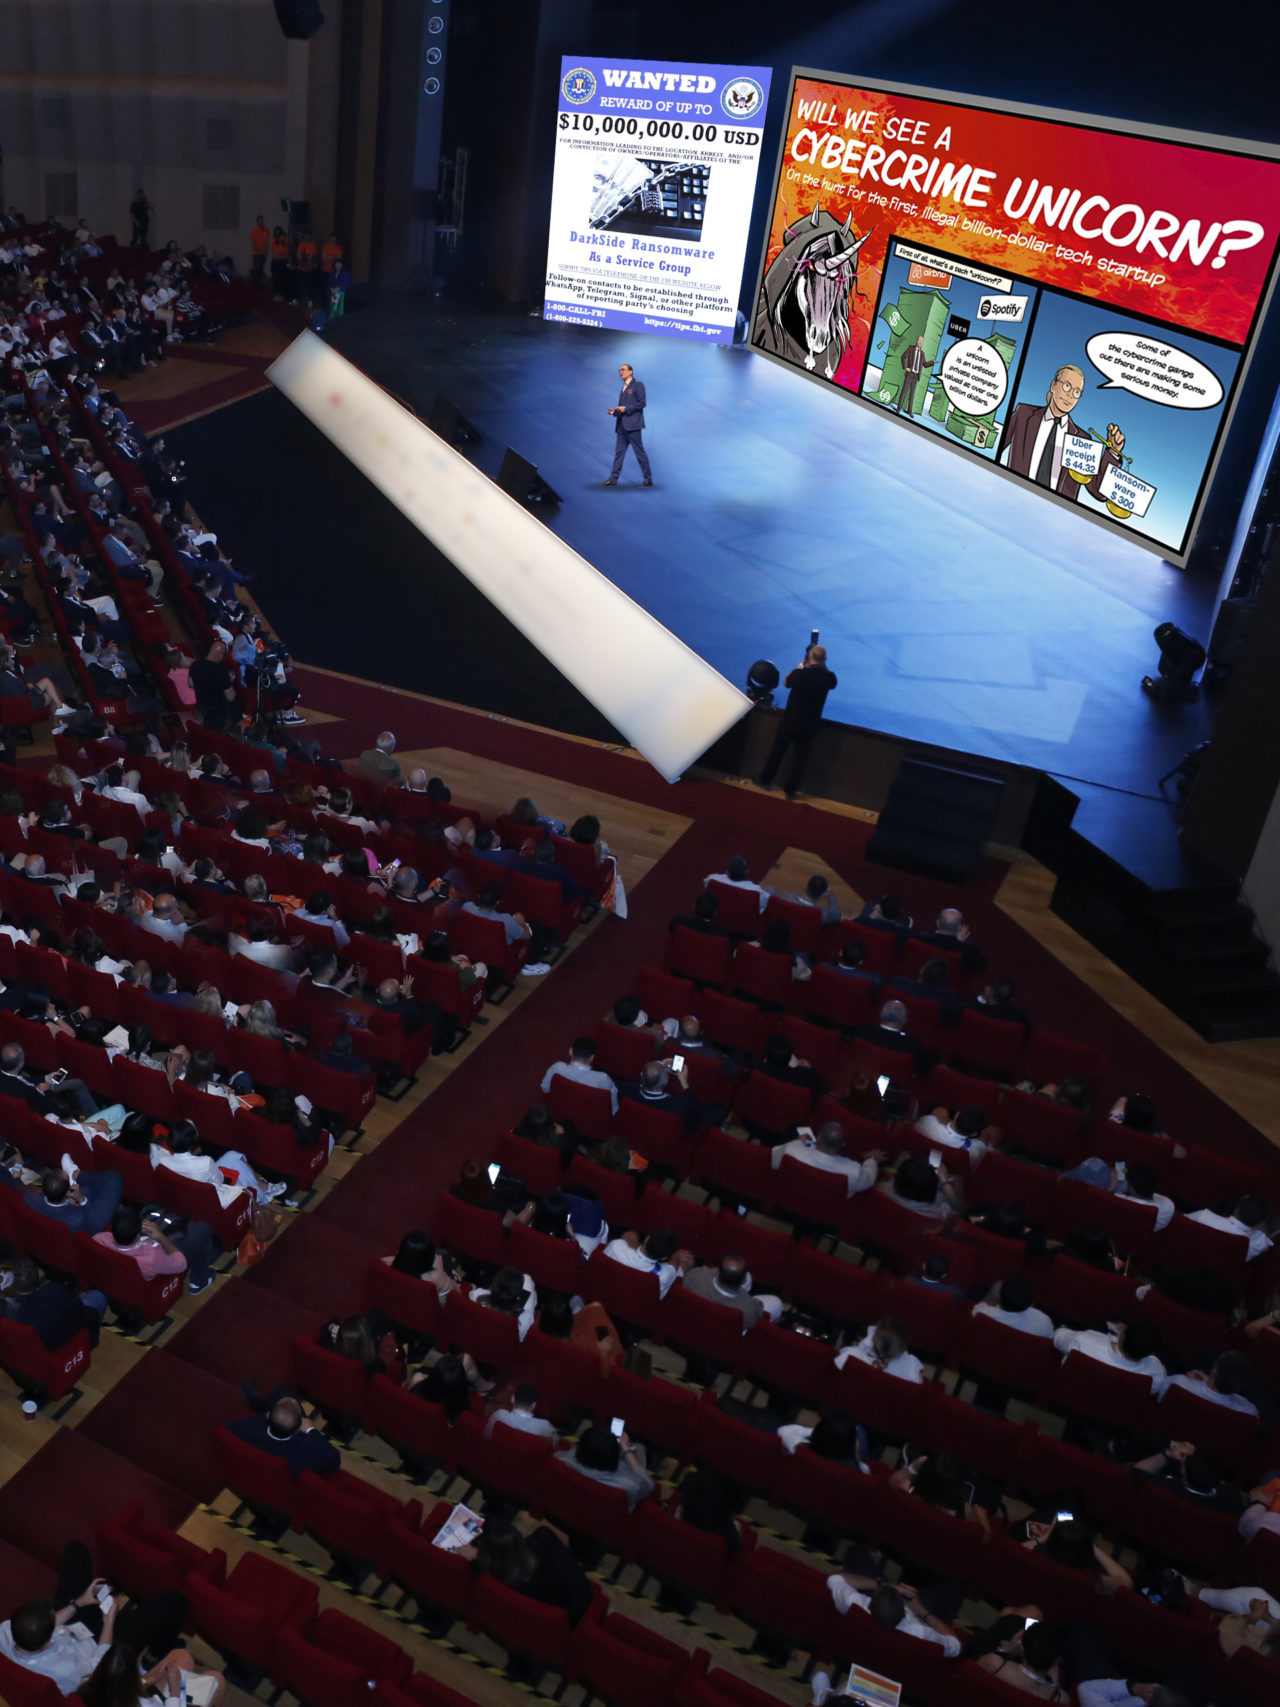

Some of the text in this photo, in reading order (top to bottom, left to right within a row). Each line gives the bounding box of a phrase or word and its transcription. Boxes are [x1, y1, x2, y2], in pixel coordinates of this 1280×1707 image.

[602, 69, 716, 94] WANTED
[600, 96, 712, 115] REWARD OF UP TO
[559, 114, 760, 146] $10,000,000.00 USD
[797, 98, 952, 151] WILL WE SEE A
[570, 144, 607, 152] CONVICTION
[572, 139, 614, 147] INFORMATION
[791, 128, 1265, 269] CYBERCRIME UNICORN?
[786, 168, 801, 182] On
[802, 172, 819, 188] the
[821, 175, 845, 194] hunt
[867, 190, 887, 207] the
[922, 206, 959, 228] illegal
[962, 213, 1054, 254] billion-dollar
[1055, 244, 1093, 266] tech
[1097, 256, 1166, 287] startup
[570, 230, 715, 260] DarkSide Ransomware
[589, 252, 691, 277] As a Service Group
[604, 269, 637, 279] TELEPHONE
[929, 257, 948, 269] what's
[954, 266, 968, 276] tech
[546, 280, 585, 292] WhatsApp,
[587, 286, 628, 298] Telegram,
[630, 292, 658, 303] Signal,
[671, 299, 693, 307] other
[695, 302, 733, 312] platform
[548, 272, 729, 305] Follow-on contacts to be established through
[546, 302, 607, 318] 1-800-CALL-FBI
[586, 295, 623, 306] reporting
[625, 300, 654, 309] party's
[656, 304, 694, 316] choosing
[991, 304, 1020, 317] Spotify
[644, 317, 722, 335] https://tips.fbi.gov
[950, 323, 967, 333] UBER
[966, 352, 990, 364] unicorn
[1136, 341, 1172, 358] Some of
[971, 364, 997, 378] unlisted
[1108, 344, 1194, 379] the cybercrime gangs
[949, 365, 999, 390] private company
[1099, 353, 1206, 396] out there are making some
[944, 373, 963, 384] valued
[971, 385, 986, 394] over
[986, 392, 999, 400] one
[1121, 372, 1179, 398] serious money.
[1072, 437, 1093, 450] Uber
[1065, 448, 1096, 463] receipt
[1065, 458, 1096, 474] $ 44.32
[1110, 466, 1150, 493] Ransom-
[1110, 491, 1134, 510] $ 300
[1114, 482, 1136, 499] ware
[162, 1278, 179, 1298] C12
[64, 1351, 84, 1372] C13
